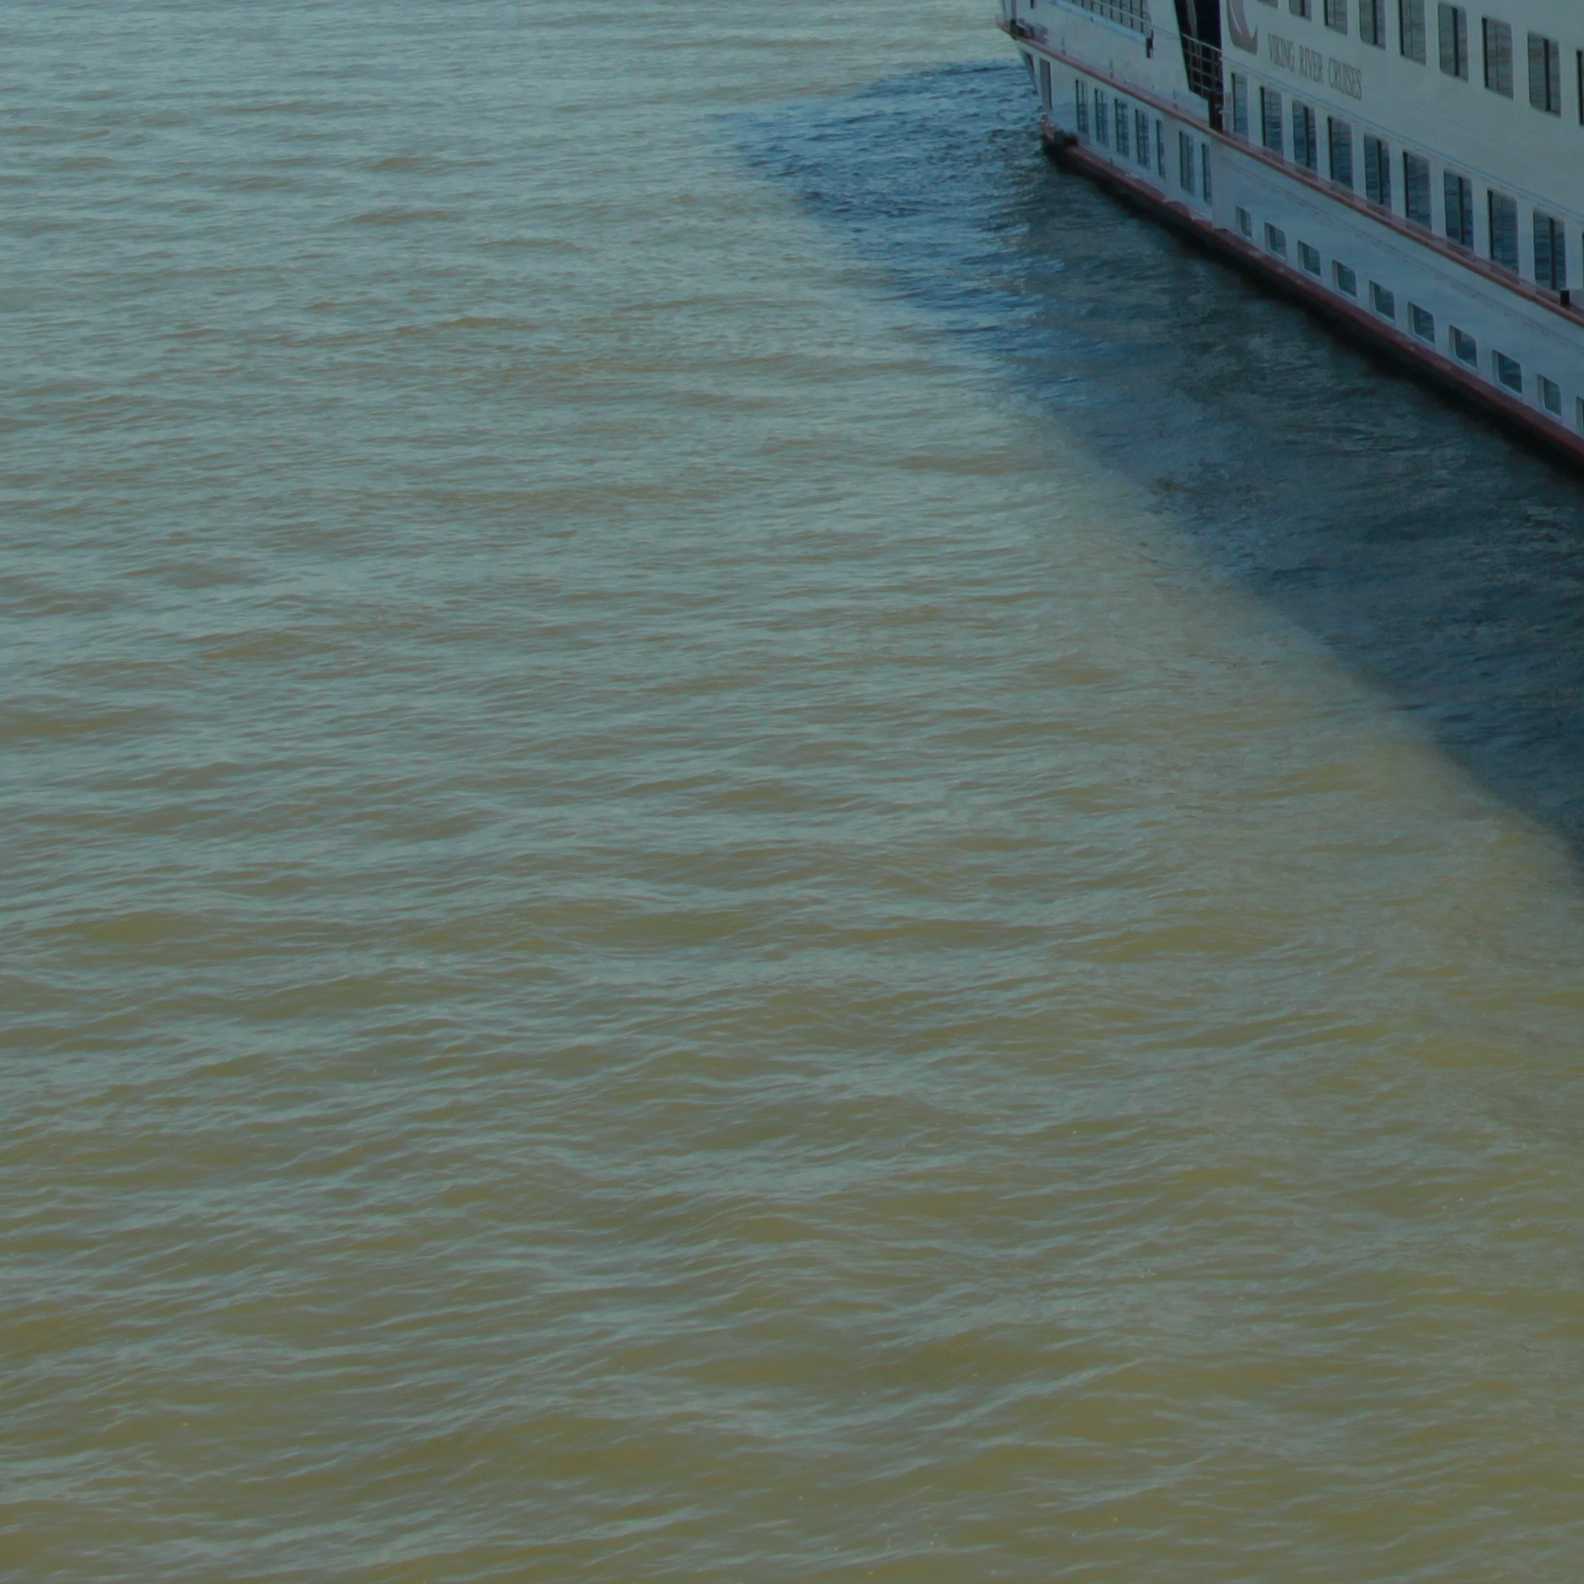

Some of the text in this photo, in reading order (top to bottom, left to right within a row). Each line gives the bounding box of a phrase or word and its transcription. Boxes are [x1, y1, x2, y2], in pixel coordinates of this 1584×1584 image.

[1268, 33, 1361, 100] VIKING RIVER CRUISES
